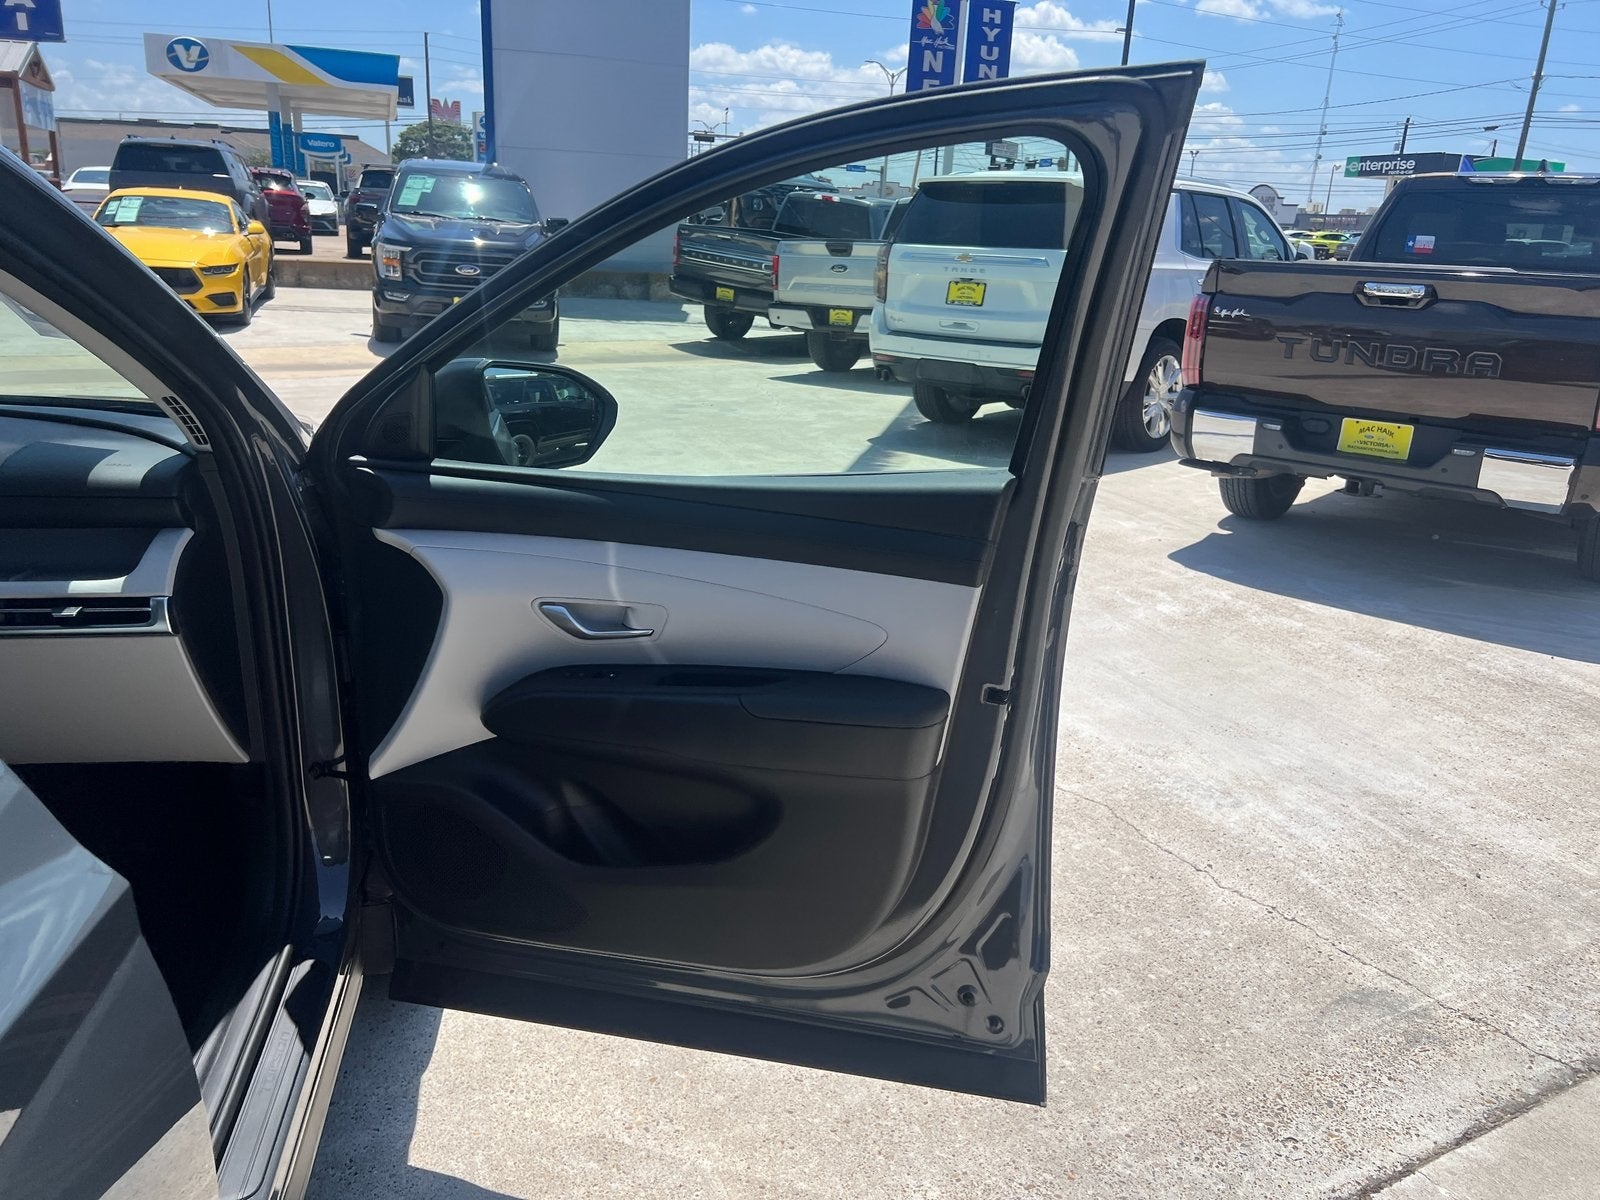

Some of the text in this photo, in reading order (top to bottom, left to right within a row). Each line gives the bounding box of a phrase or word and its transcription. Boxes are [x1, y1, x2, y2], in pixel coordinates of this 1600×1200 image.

[307, 139, 335, 147] Valero
[1348, 158, 1416, 173] enterprise
[1276, 335, 1503, 377] TUNDRA
[1359, 426, 1375, 434] MAC
[1360, 440, 1388, 448] VICTORIA
